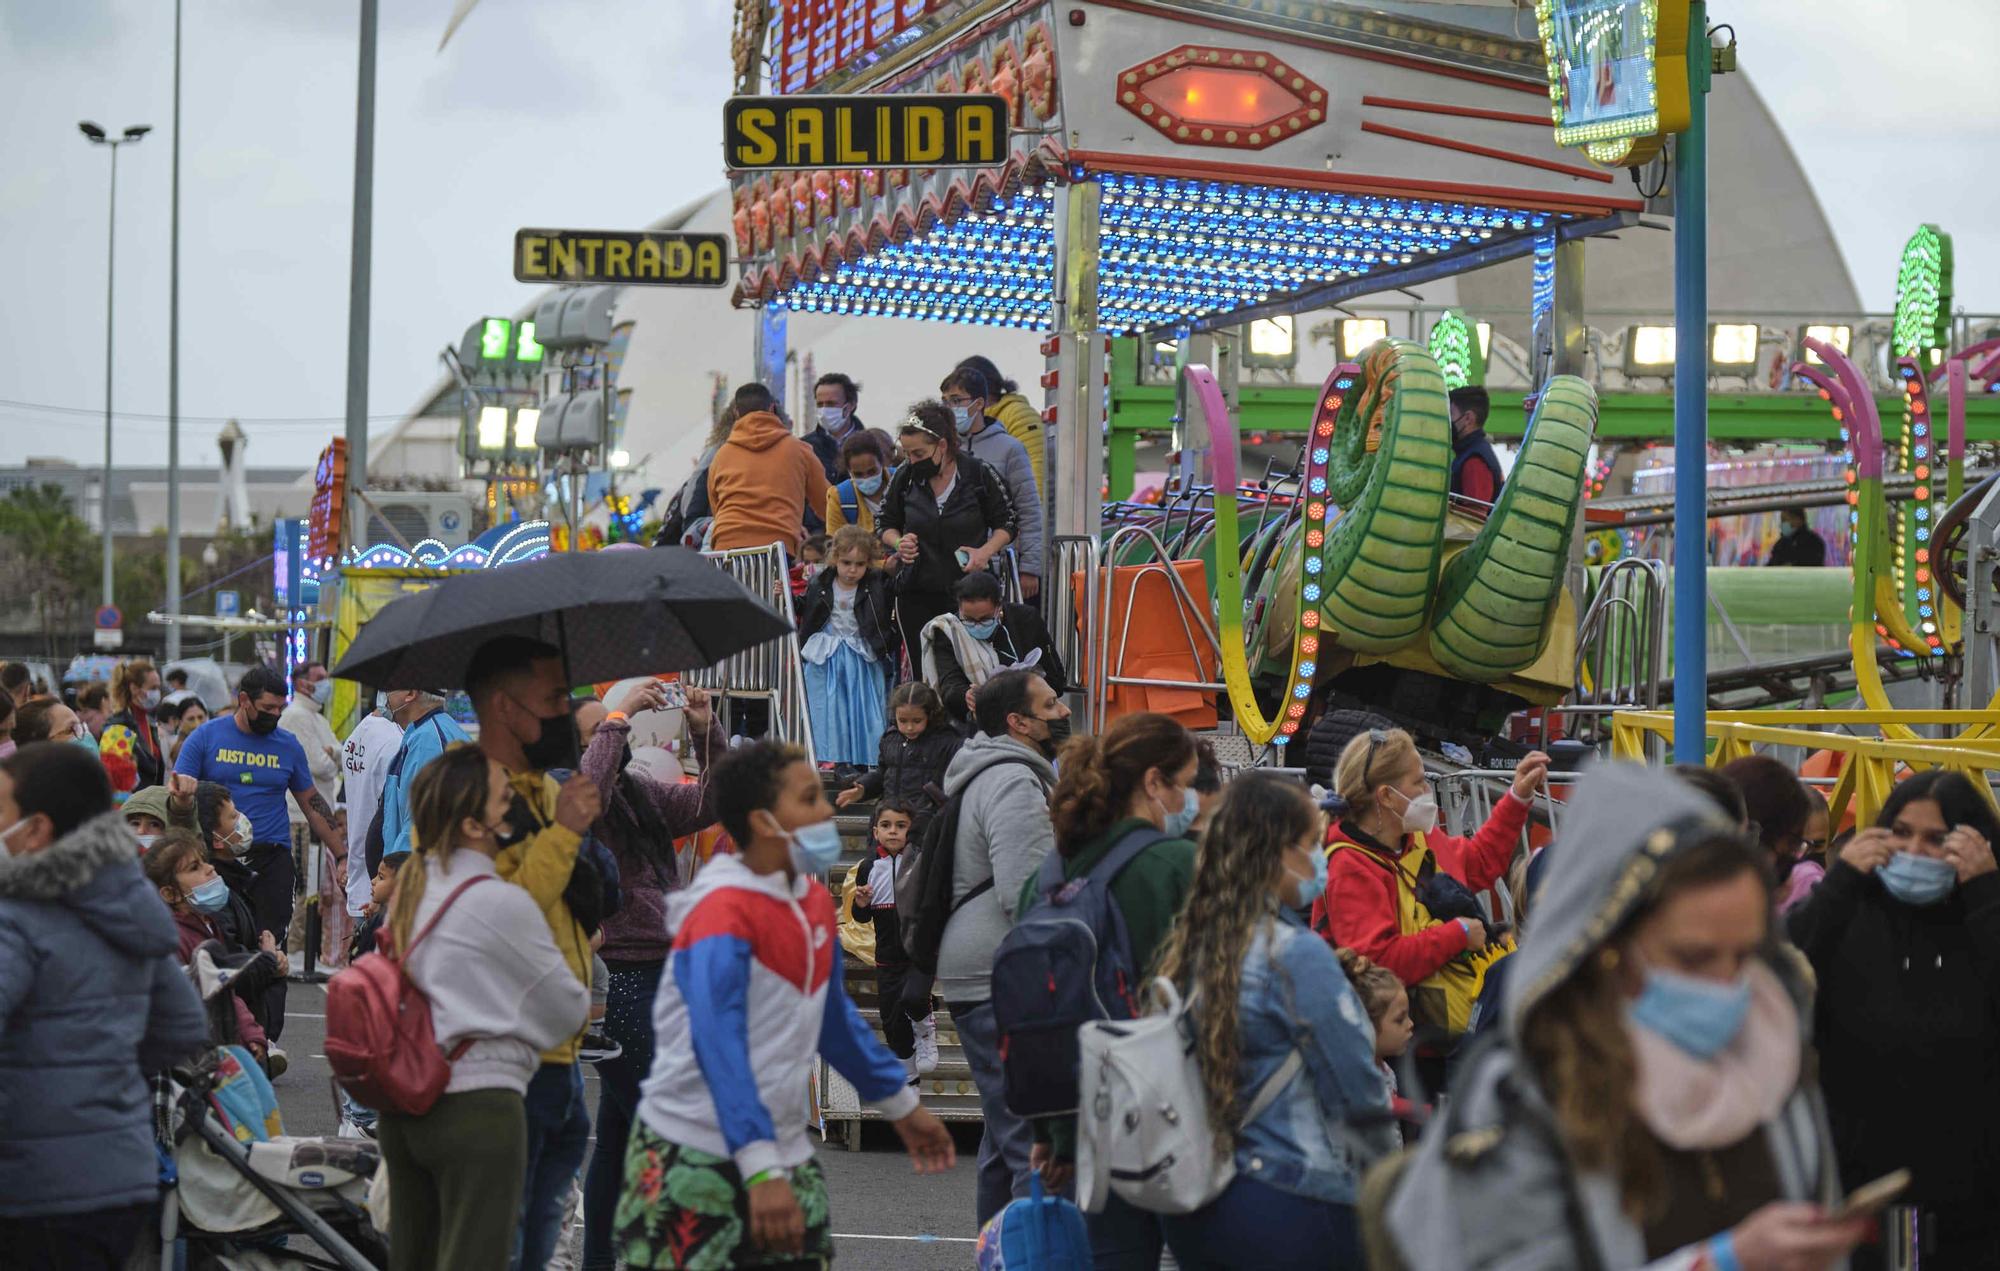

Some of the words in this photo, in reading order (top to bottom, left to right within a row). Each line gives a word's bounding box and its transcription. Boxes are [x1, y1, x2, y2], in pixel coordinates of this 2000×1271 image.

[736, 104, 994, 165] SALIDA
[522, 236, 721, 280] ENTRADA
[221, 593, 233, 610] P
[215, 747, 246, 765] JUST
[246, 752, 266, 767] DO
[267, 754, 281, 769] IT.
